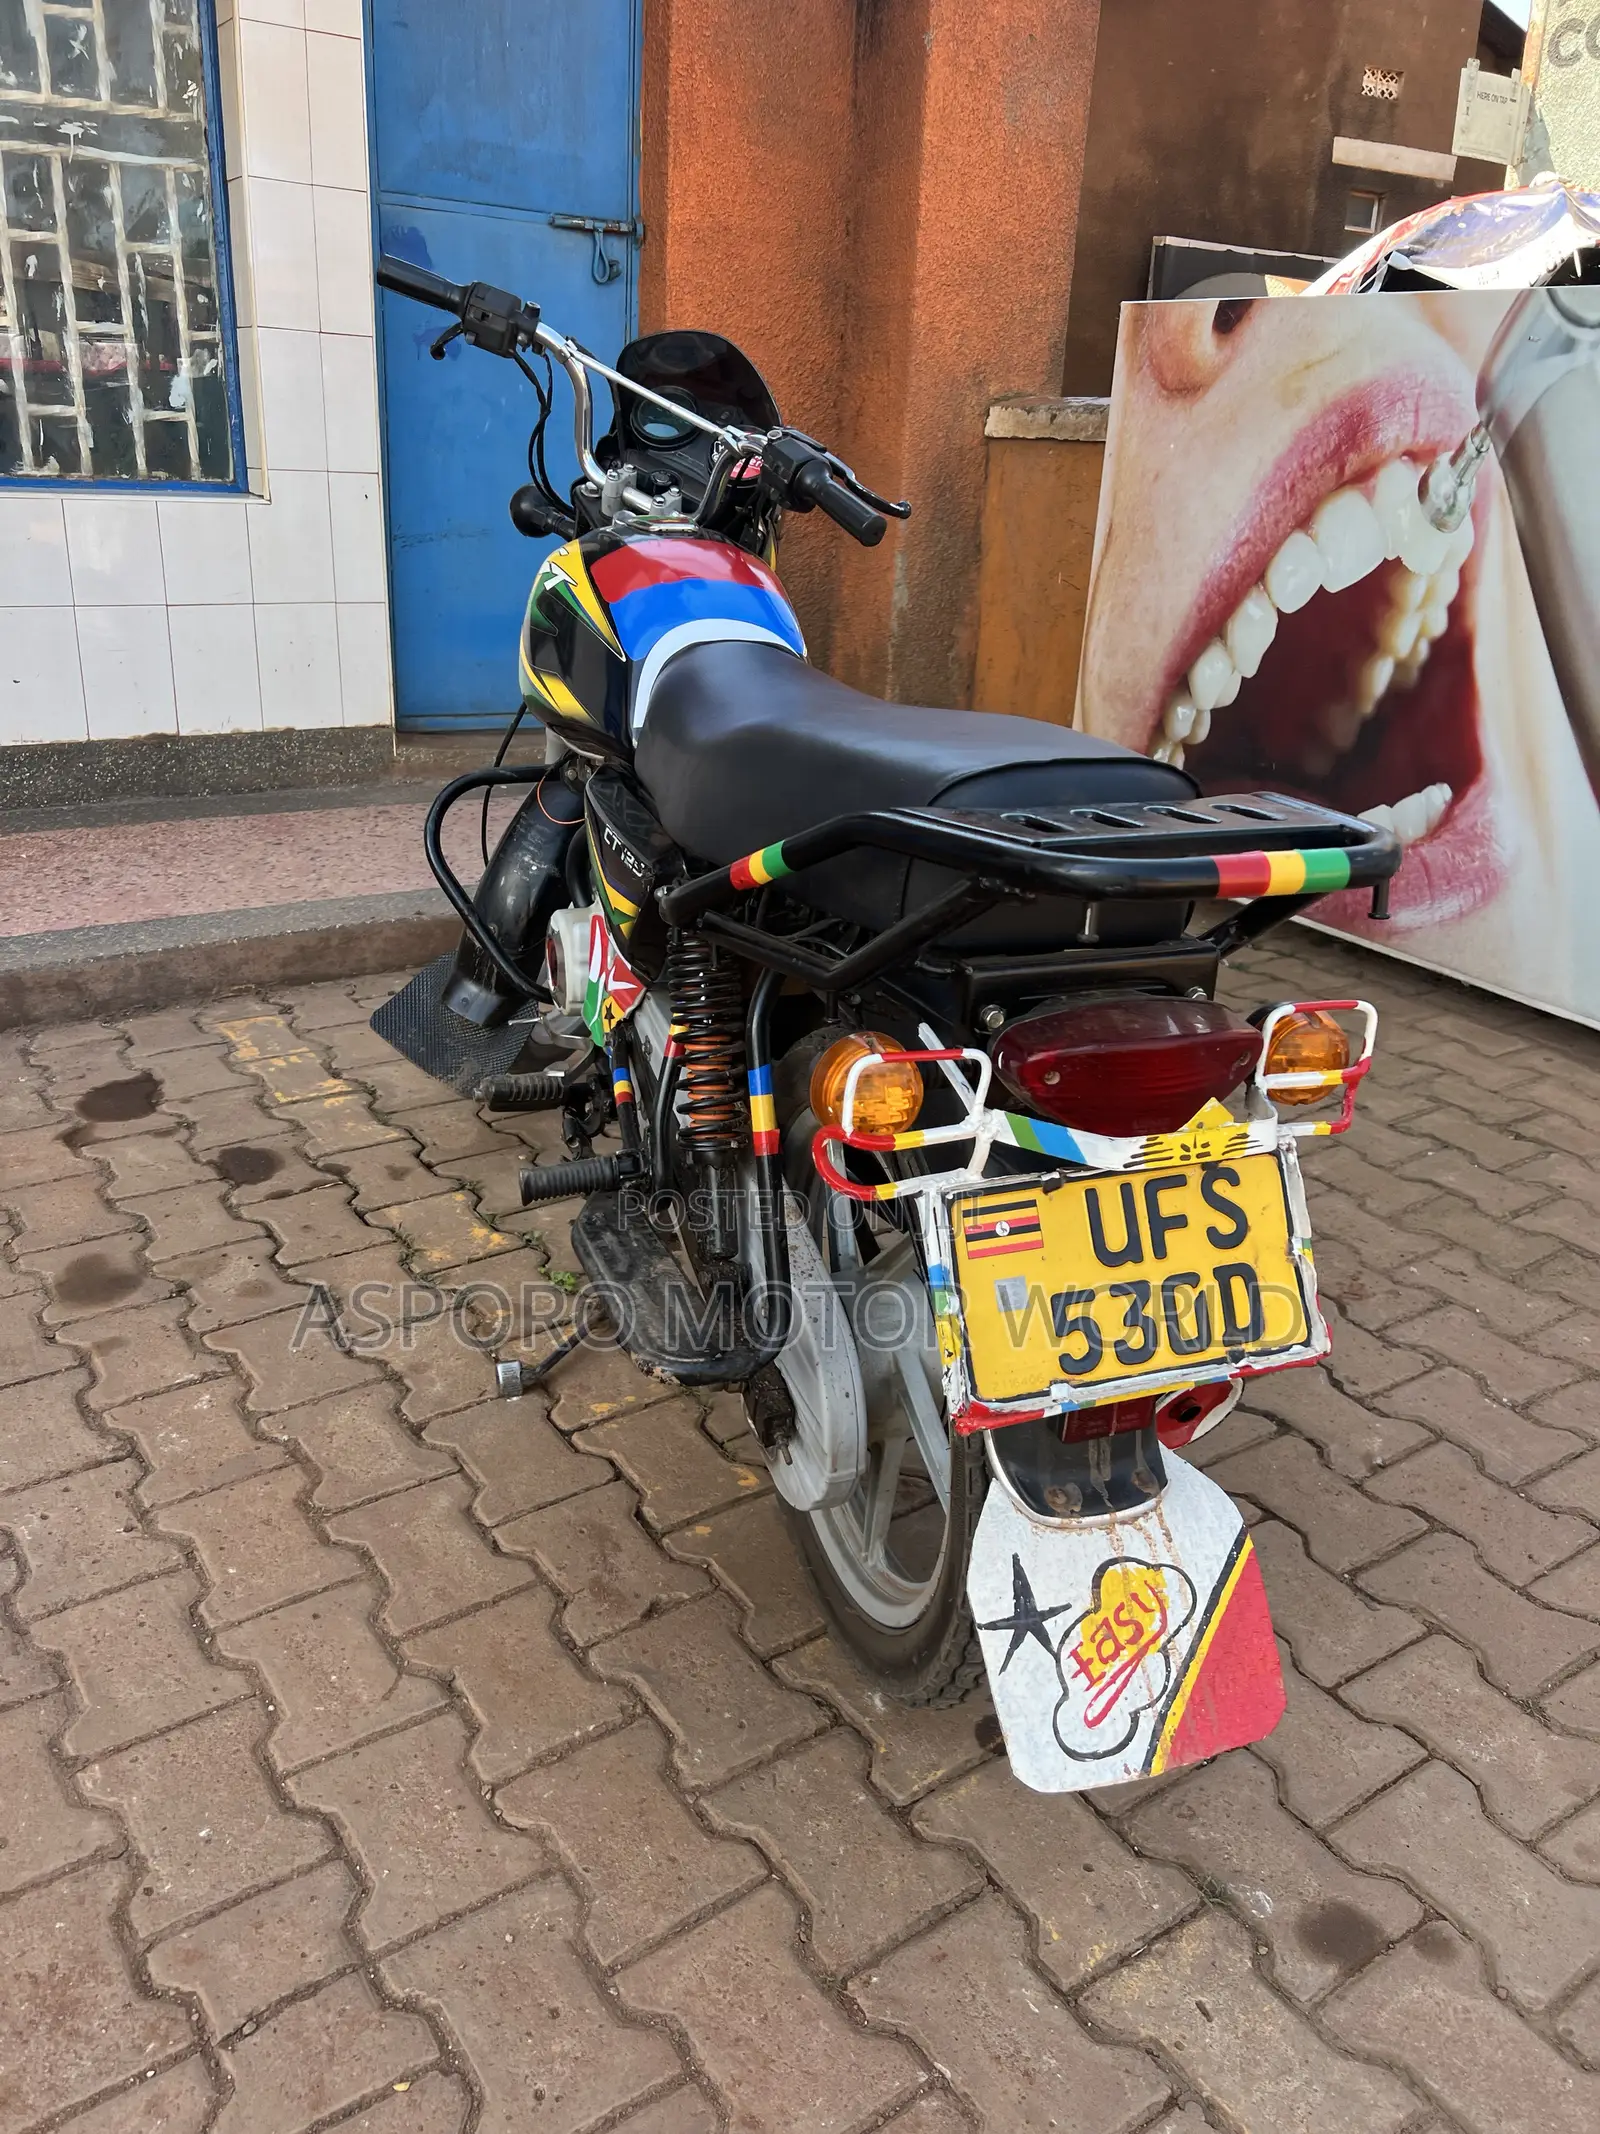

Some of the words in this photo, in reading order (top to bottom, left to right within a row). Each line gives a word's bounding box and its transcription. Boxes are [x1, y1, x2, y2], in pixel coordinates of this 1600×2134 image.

[1477, 91, 1491, 101] HERE
[1490, 93, 1499, 103] ON
[1084, 1166, 1251, 1268] UFS
[1050, 1262, 1265, 1375] 530D
[1066, 1580, 1168, 1729] Easy
